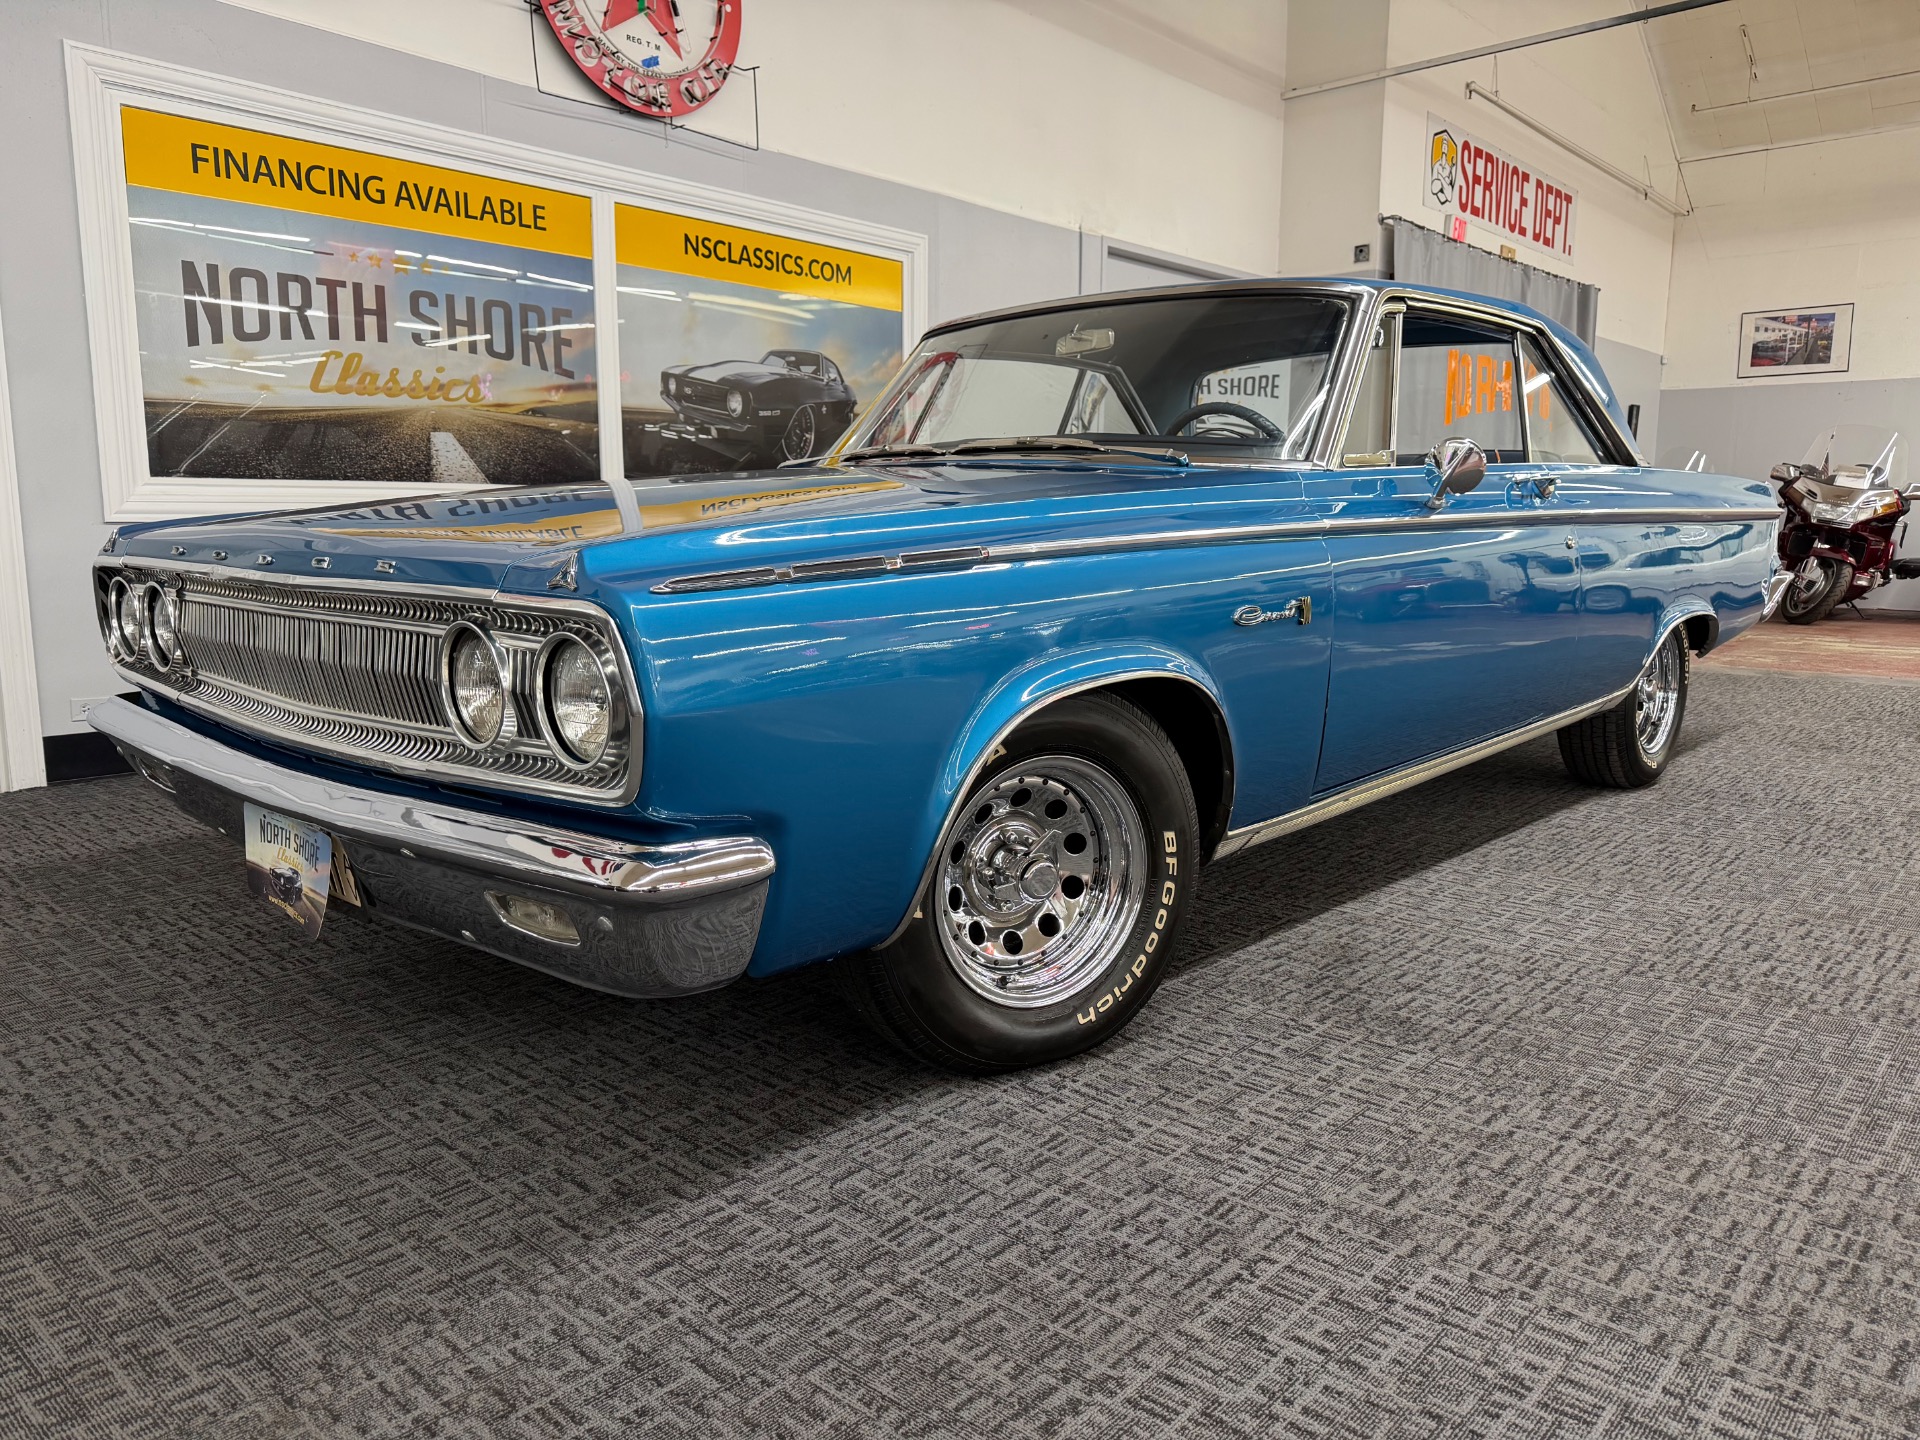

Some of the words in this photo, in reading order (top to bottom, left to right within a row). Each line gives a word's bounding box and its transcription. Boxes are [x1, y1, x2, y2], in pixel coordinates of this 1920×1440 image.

[548, 0, 673, 113] MOTOR
[598, 37, 613, 53] MAD
[190, 142, 386, 206] FINANCING
[394, 181, 547, 232] AVAILABLE
[1458, 139, 1530, 238] SERVICE
[1532, 177, 1573, 256] DEPT.
[684, 233, 852, 286] NSCLASSICS.COM
[181, 259, 388, 348] NORTH
[409, 289, 575, 381] SHORE
[310, 350, 488, 404] Classics
[1218, 374, 1280, 399] SHORE
[259, 816, 291, 849] NORTH
[293, 832, 320, 874] SHORE
